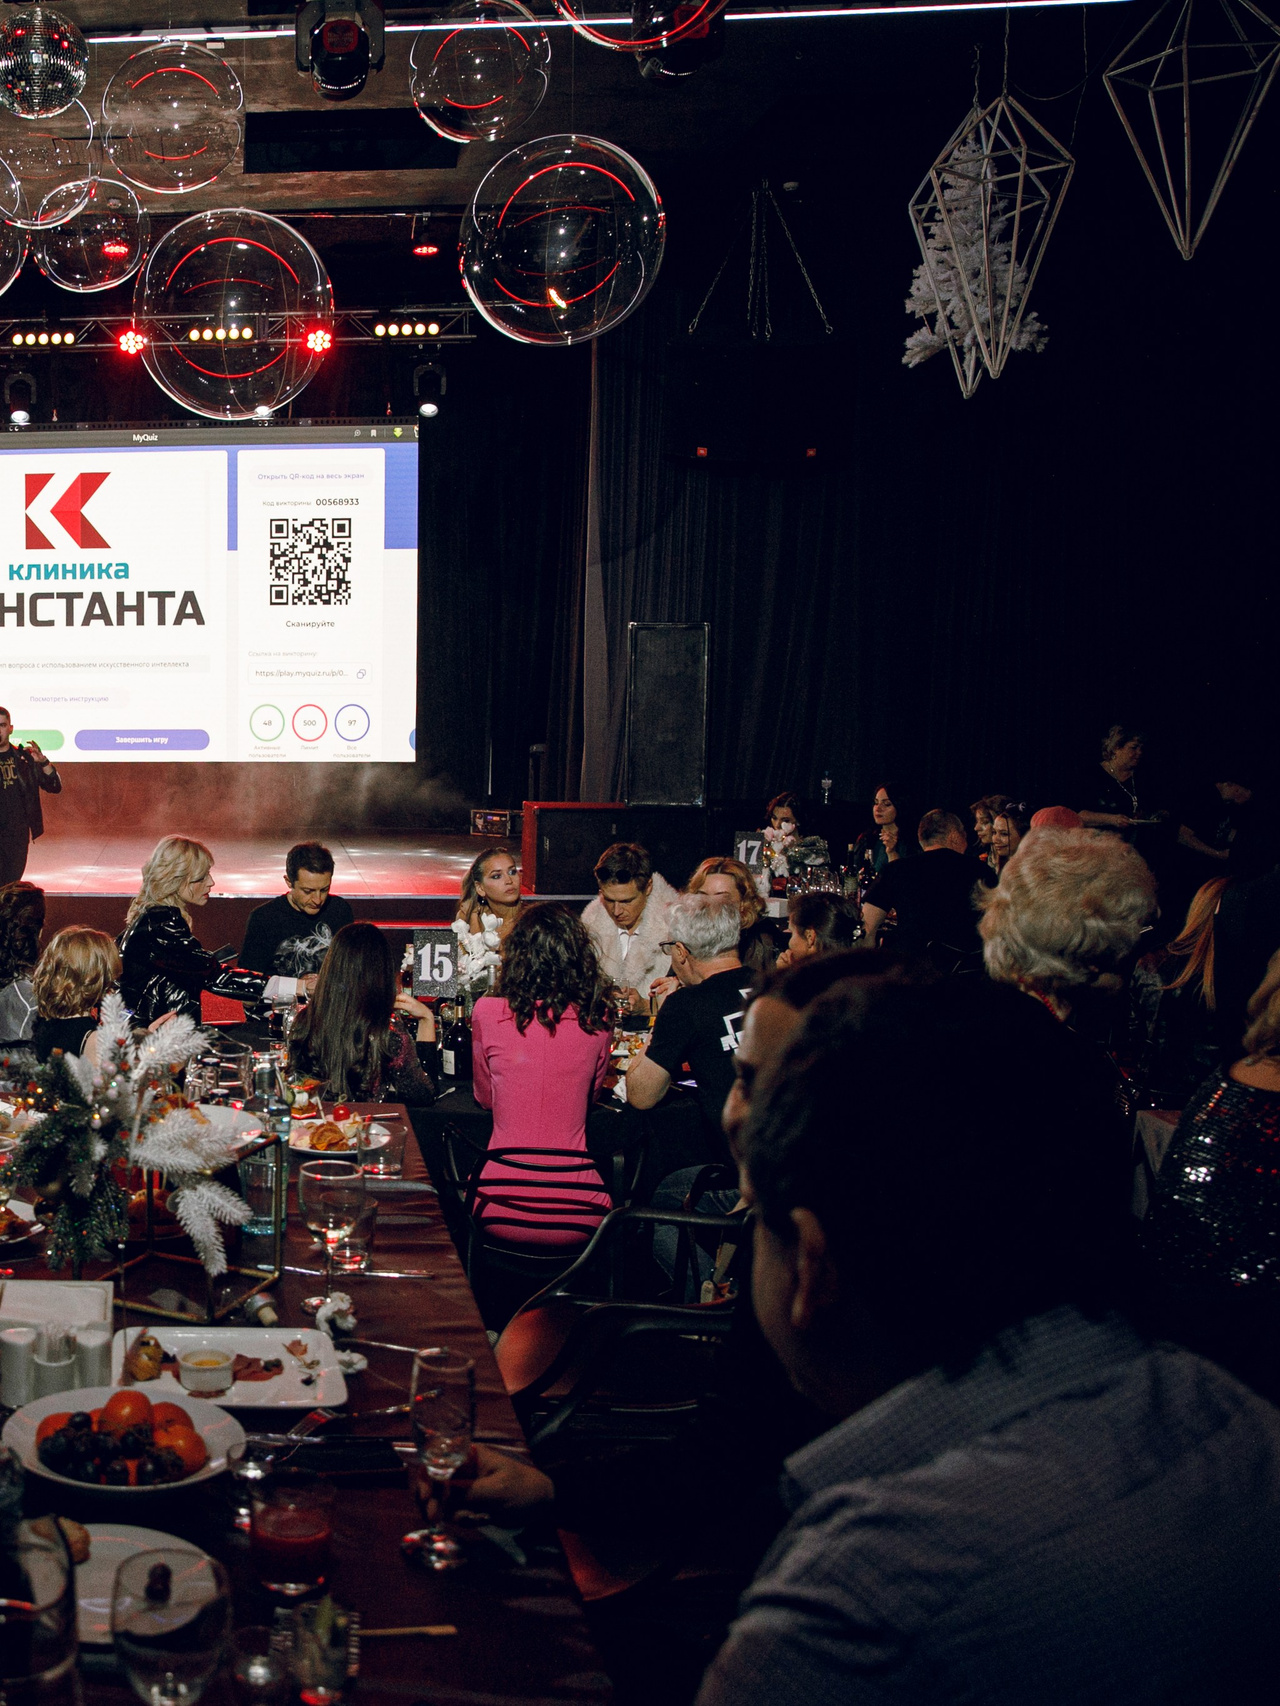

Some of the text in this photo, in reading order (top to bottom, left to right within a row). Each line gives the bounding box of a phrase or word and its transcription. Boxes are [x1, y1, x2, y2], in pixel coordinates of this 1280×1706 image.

[132, 433, 158, 443] MyQuiz
[315, 498, 360, 506] 00568933
[8, 562, 130, 581] клиника
[285, 620, 335, 628] Сканируйте
[115, 736, 169, 745] Завершить игру
[737, 840, 762, 865] 17
[418, 943, 453, 982] 15
